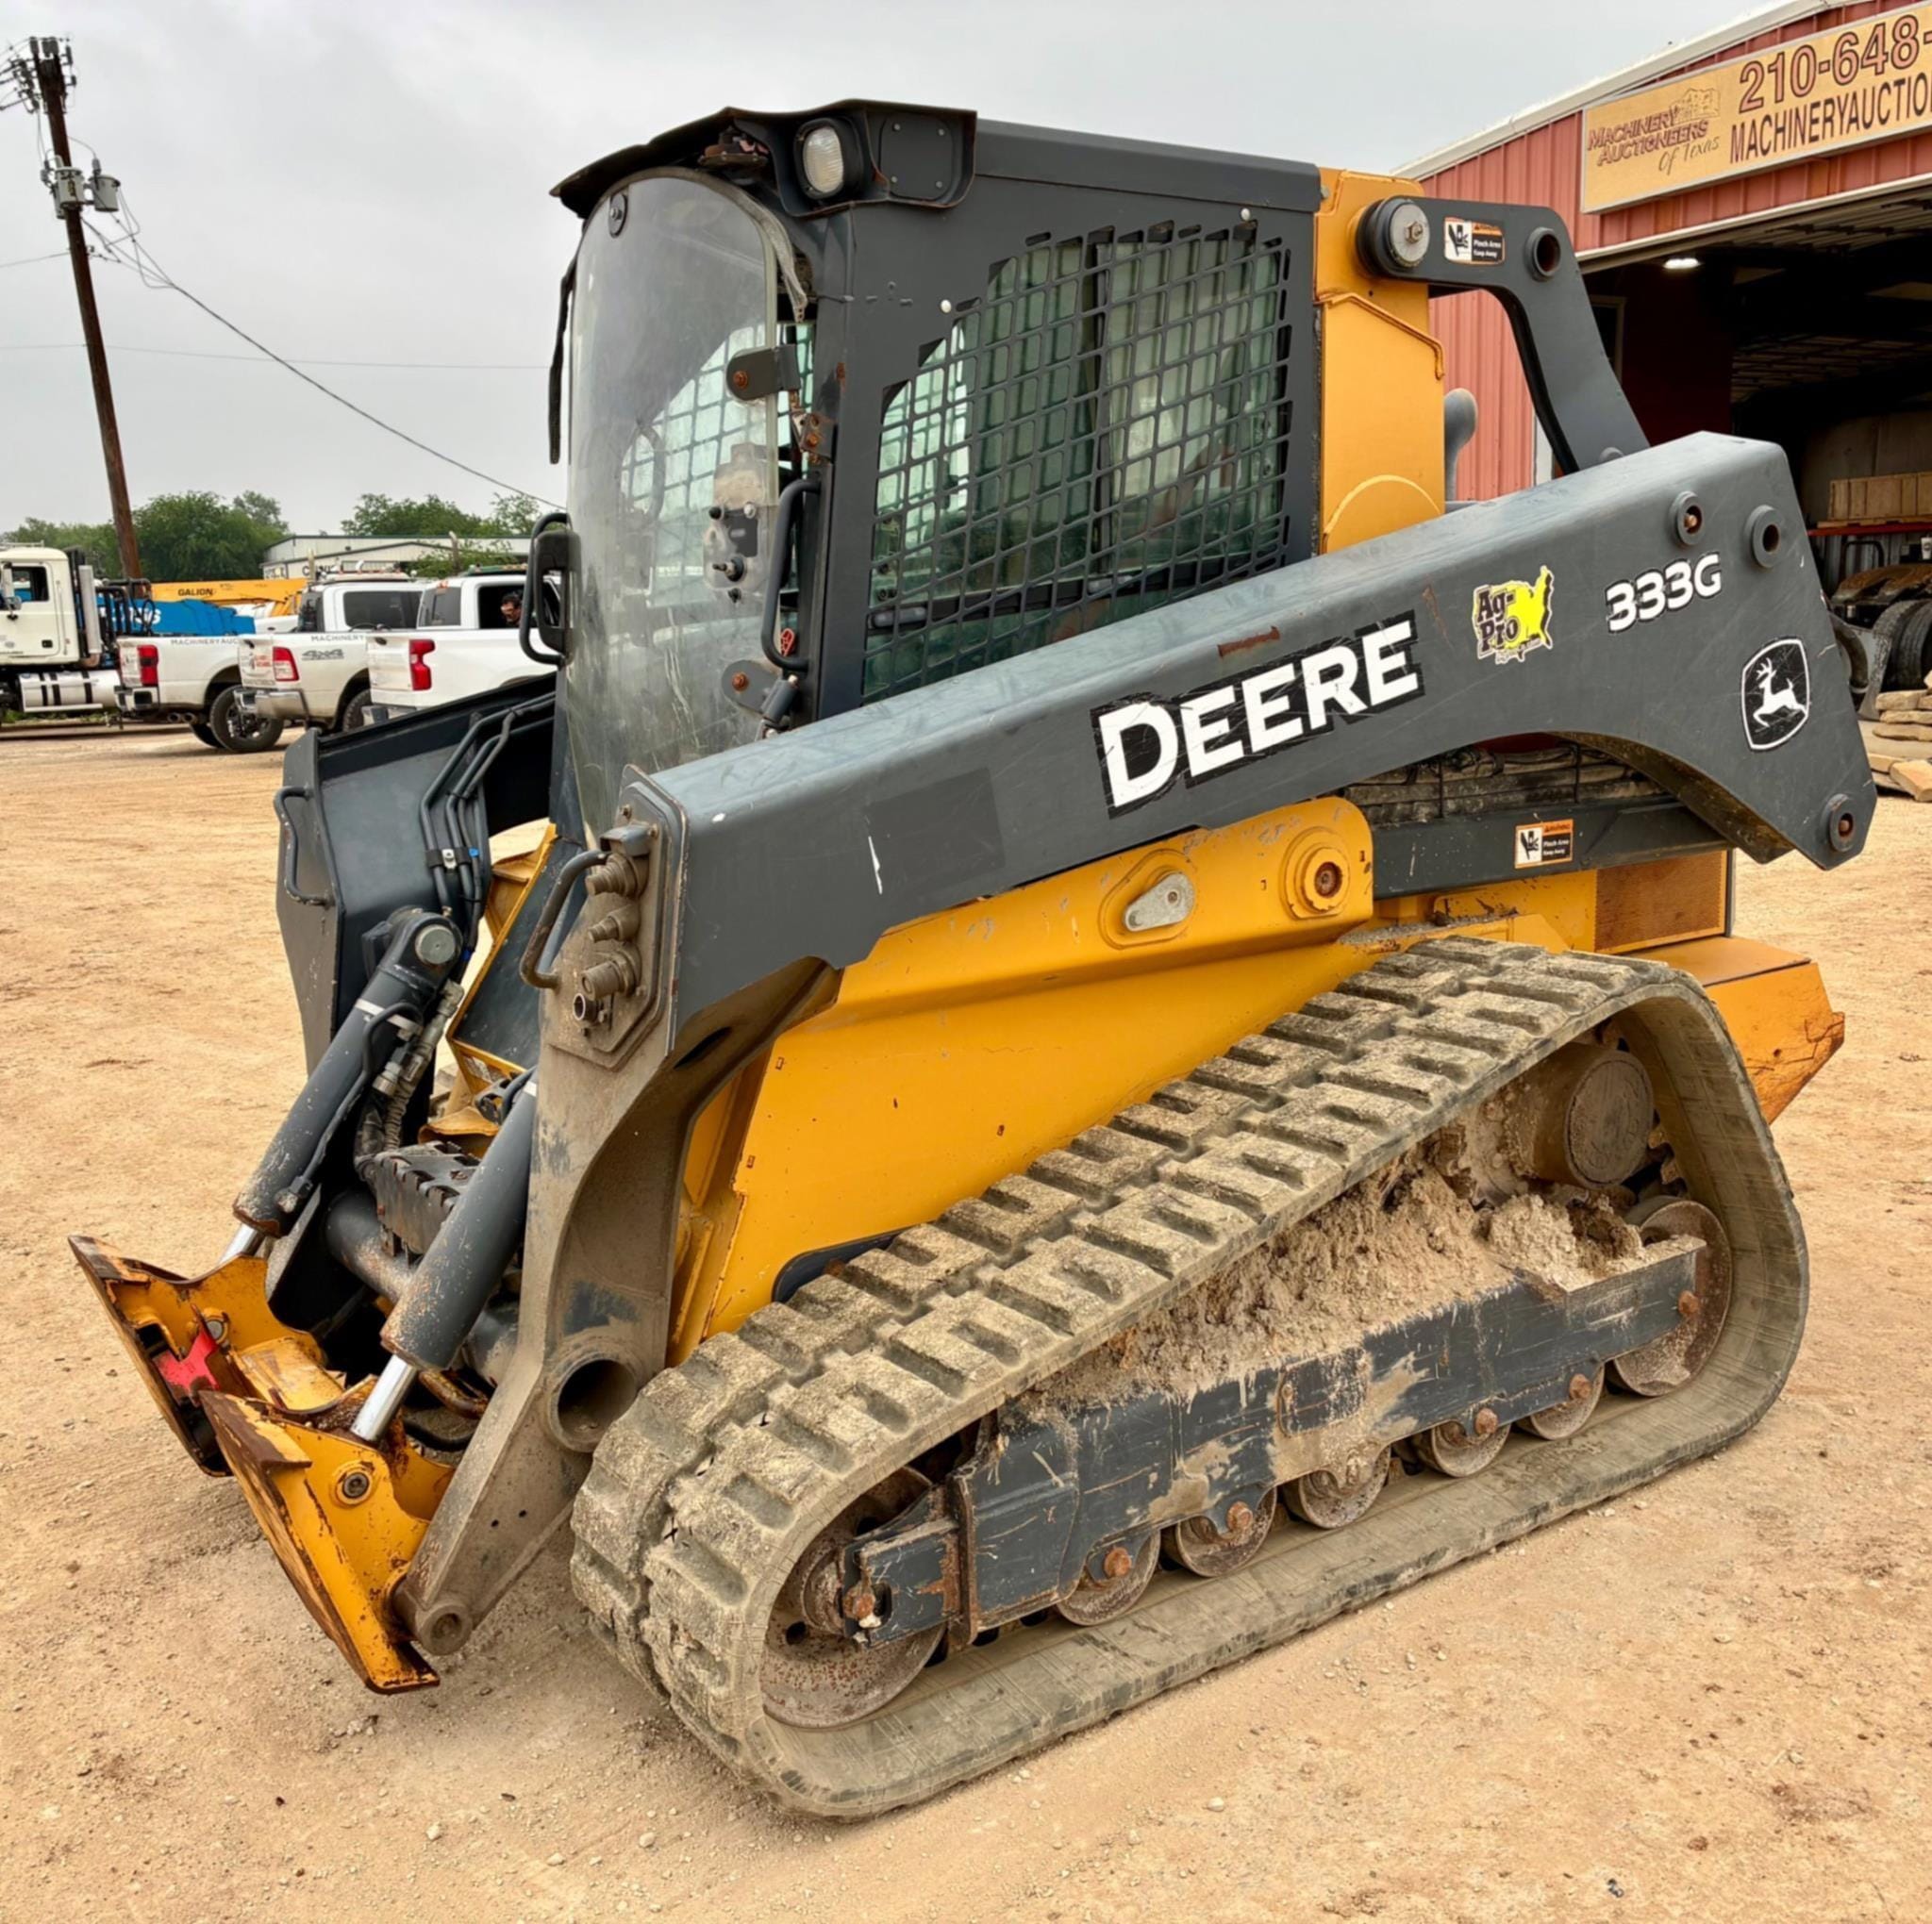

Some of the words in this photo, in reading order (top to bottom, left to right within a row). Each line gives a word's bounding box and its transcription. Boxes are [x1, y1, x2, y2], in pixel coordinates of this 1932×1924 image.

[1587, 106, 1679, 151] MACHINERY
[1730, 72, 1932, 164] MACHINERYAUCTIO
[1597, 119, 1708, 166] AUCTIONEERS
[1682, 136, 1720, 162] Texas
[177, 589, 213, 597] GALION
[1477, 590, 1514, 622] Ag-
[1606, 554, 1722, 632] 333G
[1480, 619, 1518, 652] Pro
[1099, 621, 1418, 807] DEERE
